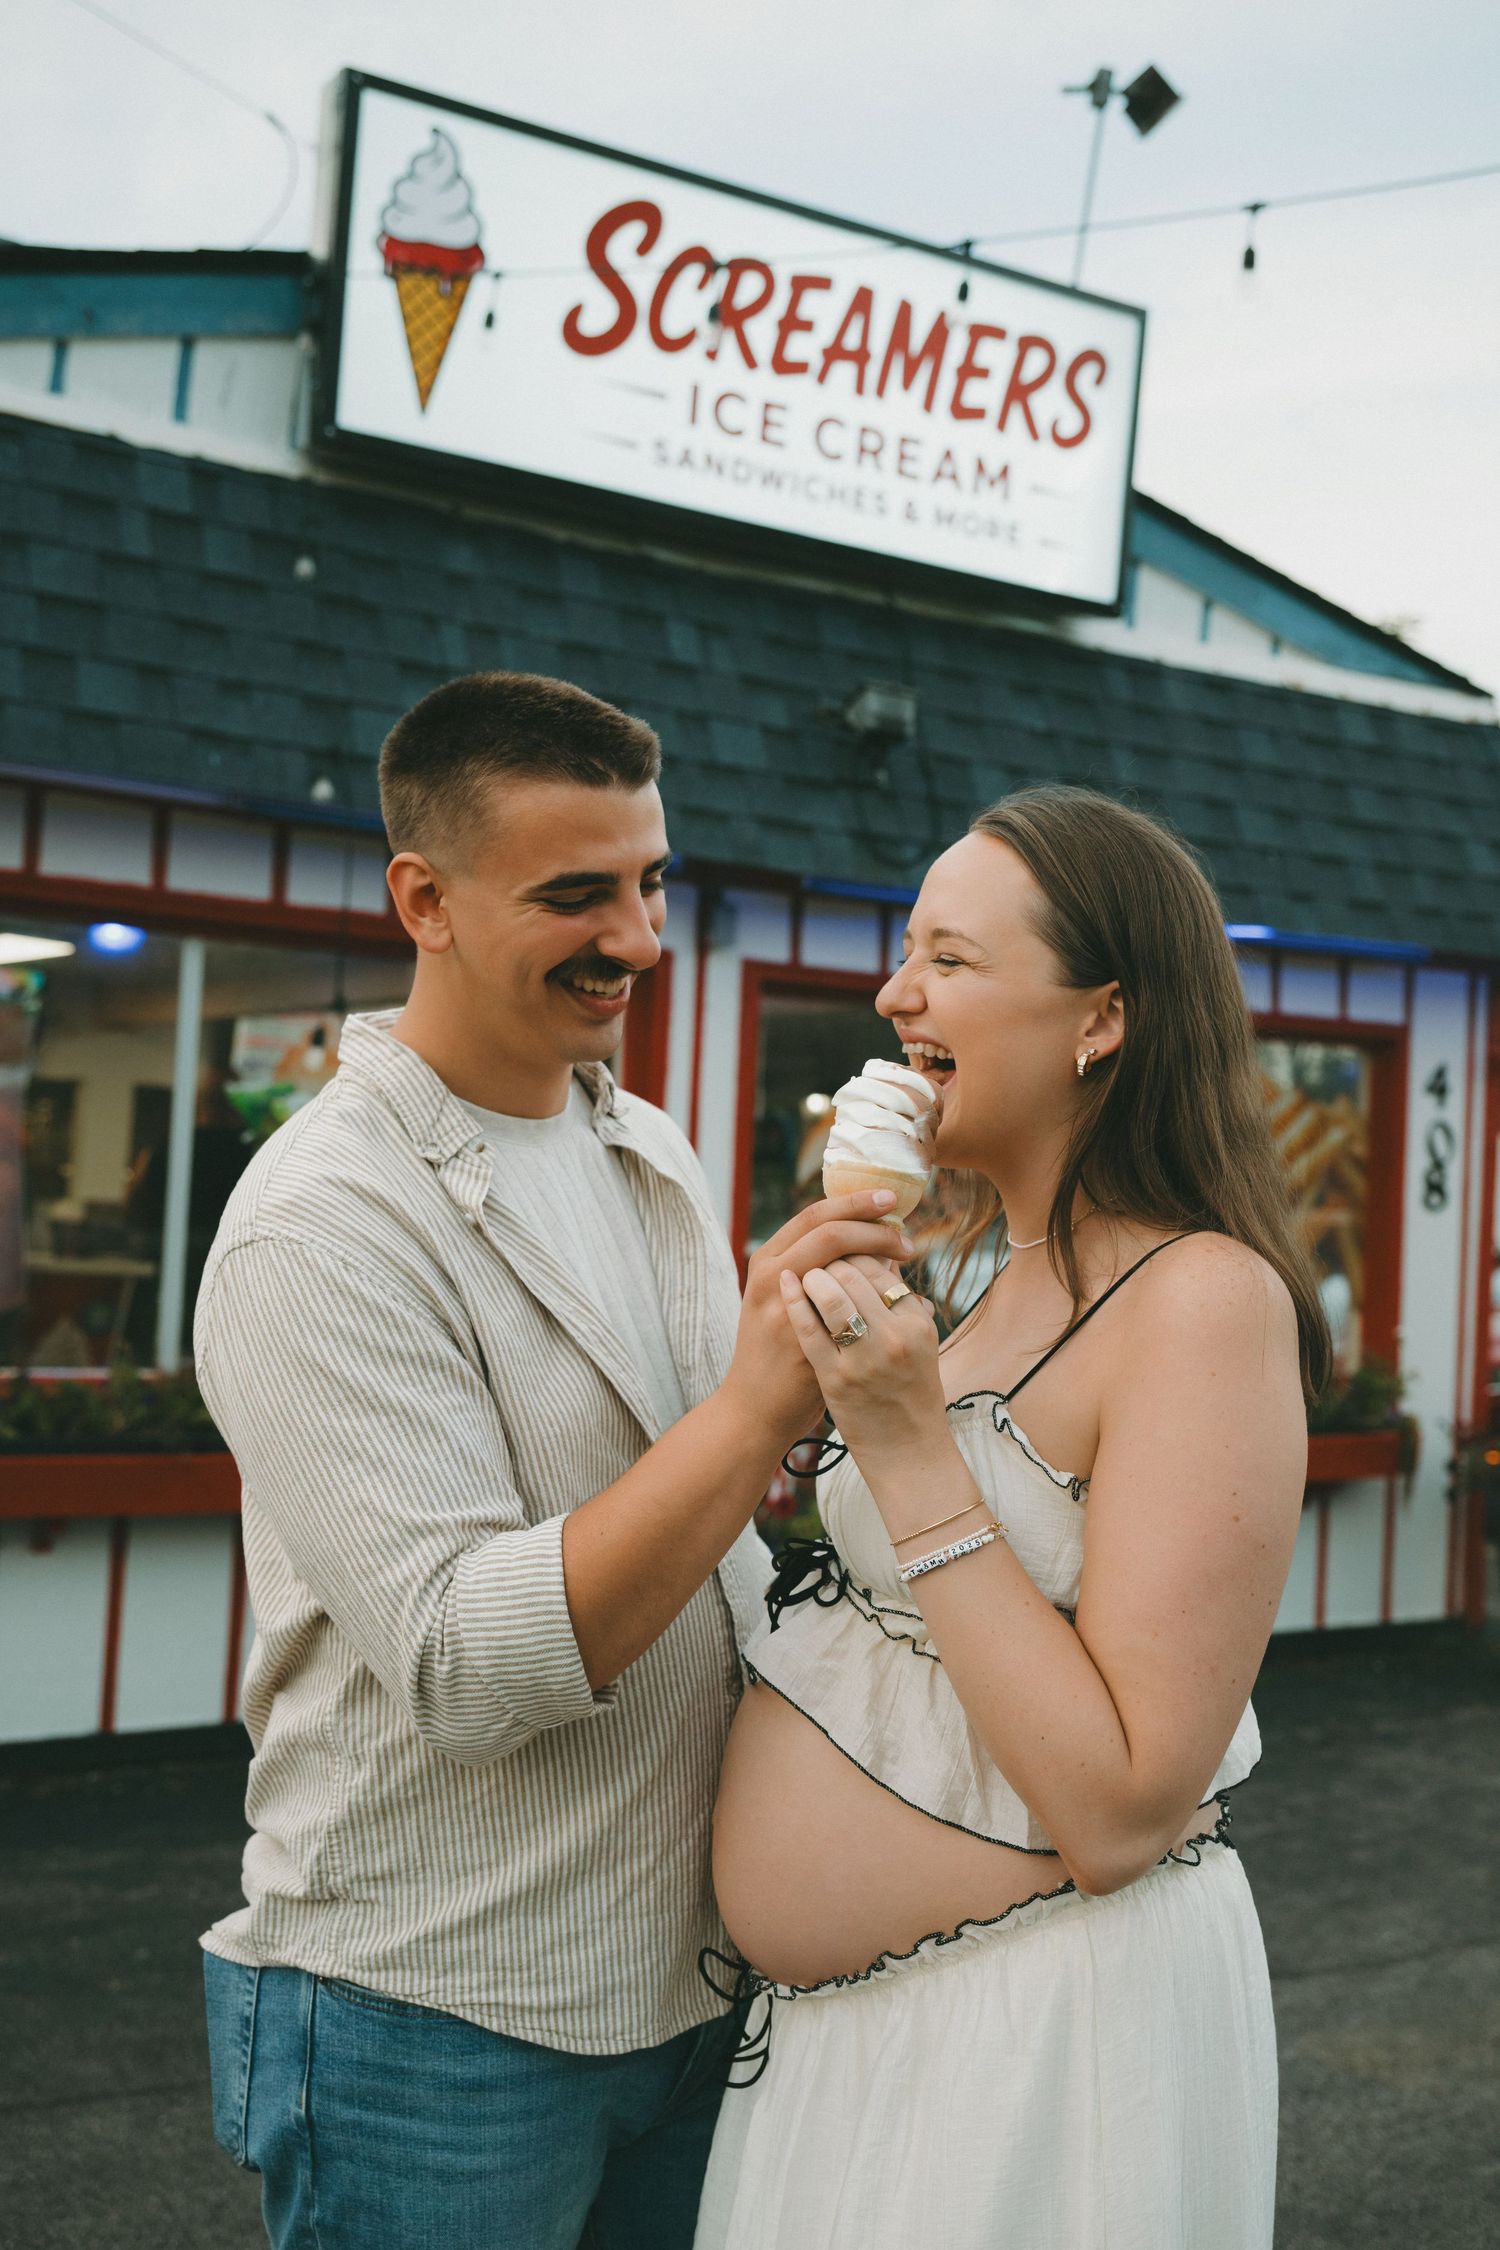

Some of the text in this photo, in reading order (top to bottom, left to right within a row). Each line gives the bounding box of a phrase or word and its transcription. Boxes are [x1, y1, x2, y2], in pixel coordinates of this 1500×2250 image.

[562, 200, 1107, 449] SCREAMERS
[653, 440, 889, 518] SANDWICHES
[934, 505, 1022, 547] MORE
[689, 384, 1012, 502] ICE CREAM
[1424, 1065, 1455, 1214] 408
[951, 1540, 981, 1555] 2025
